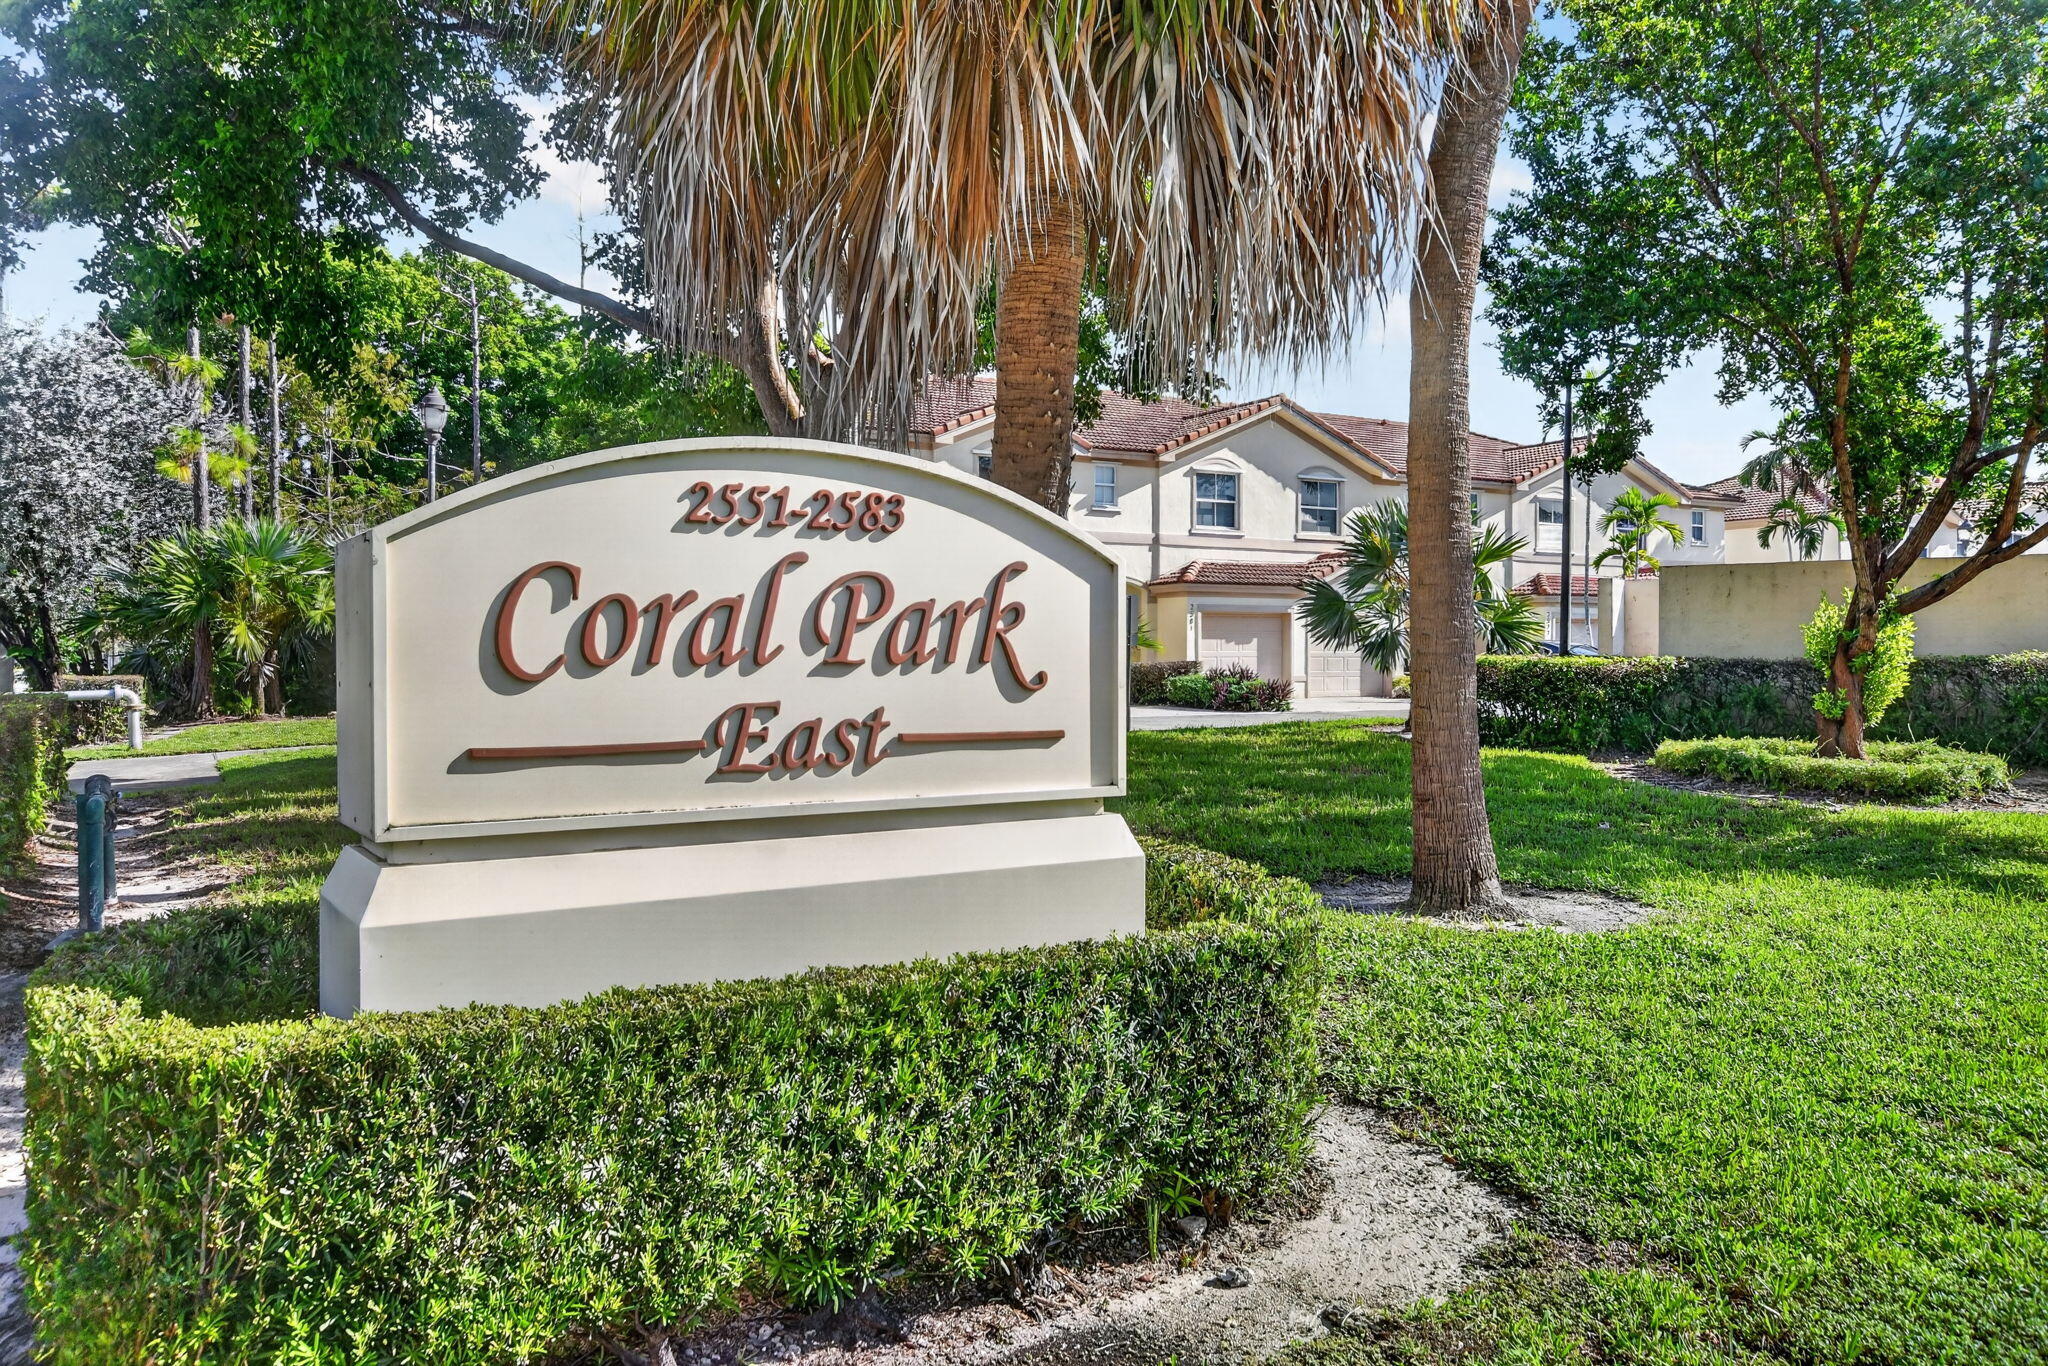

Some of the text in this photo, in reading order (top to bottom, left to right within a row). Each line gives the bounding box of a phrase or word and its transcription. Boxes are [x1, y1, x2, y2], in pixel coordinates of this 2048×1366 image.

[684, 481, 905, 533] 2551-2583
[493, 551, 1049, 691] Coral Park
[713, 700, 891, 774] East
